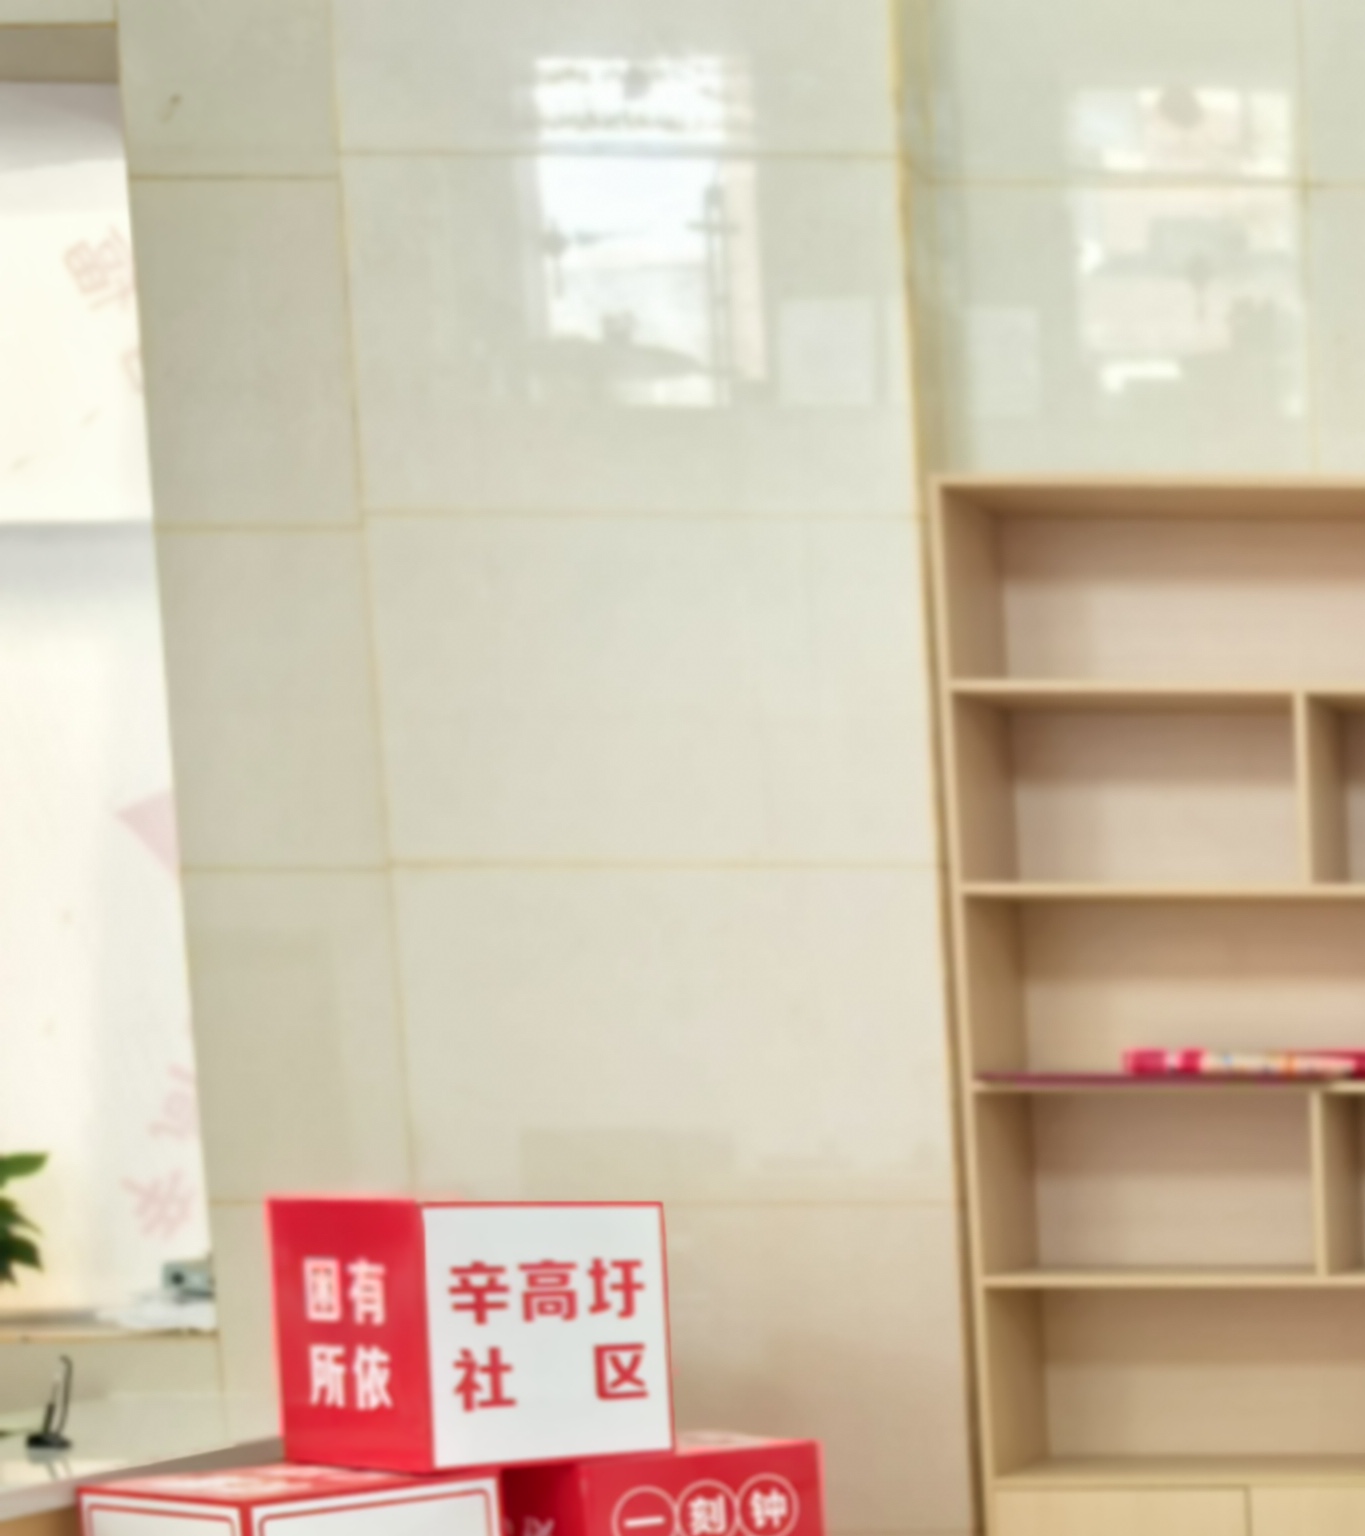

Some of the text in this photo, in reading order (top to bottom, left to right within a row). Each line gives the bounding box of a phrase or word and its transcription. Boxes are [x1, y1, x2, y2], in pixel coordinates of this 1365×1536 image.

[448, 1257, 646, 1326] 辛高圩
[309, 1344, 393, 1412] 所依
[623, 1487, 790, 1536] 一刻钟
